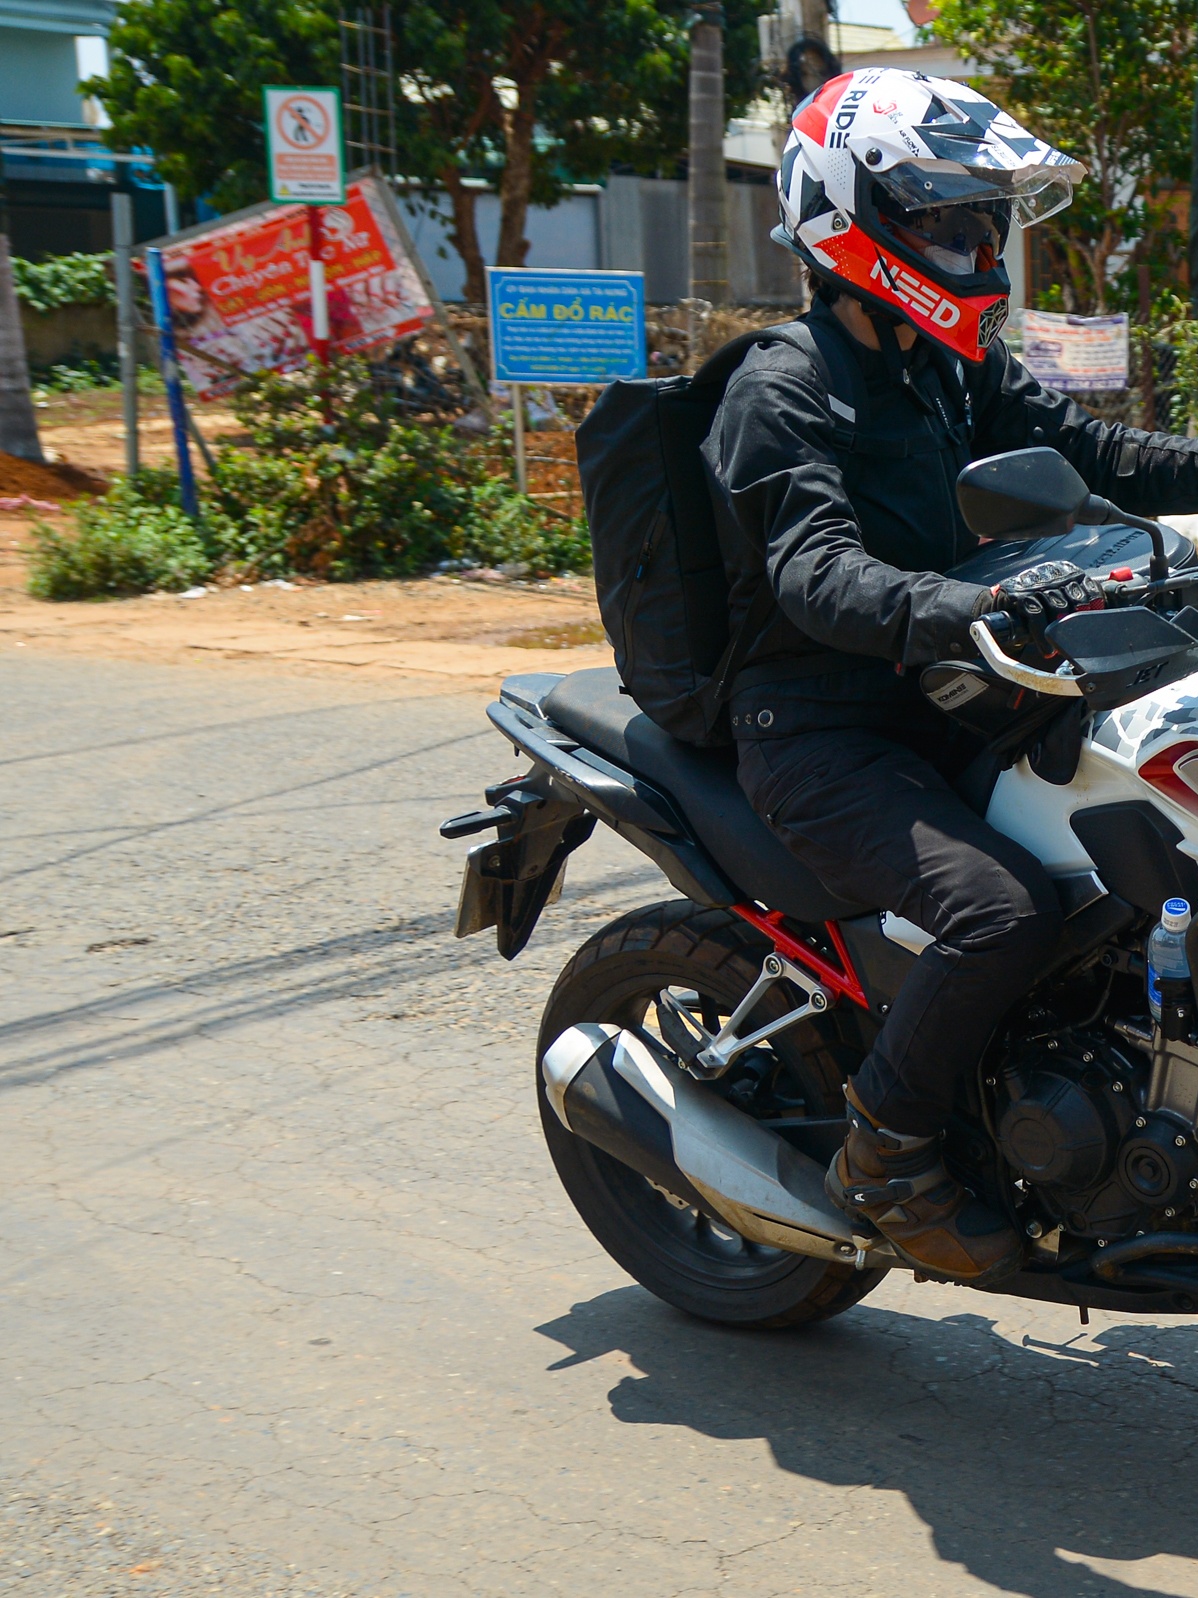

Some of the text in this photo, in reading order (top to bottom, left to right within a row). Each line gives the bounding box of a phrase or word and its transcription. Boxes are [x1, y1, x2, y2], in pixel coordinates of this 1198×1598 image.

[870, 256, 961, 329] NEED
[500, 296, 634, 322] CẤM ĐỔ RÁC
[1125, 661, 1169, 689] JET
